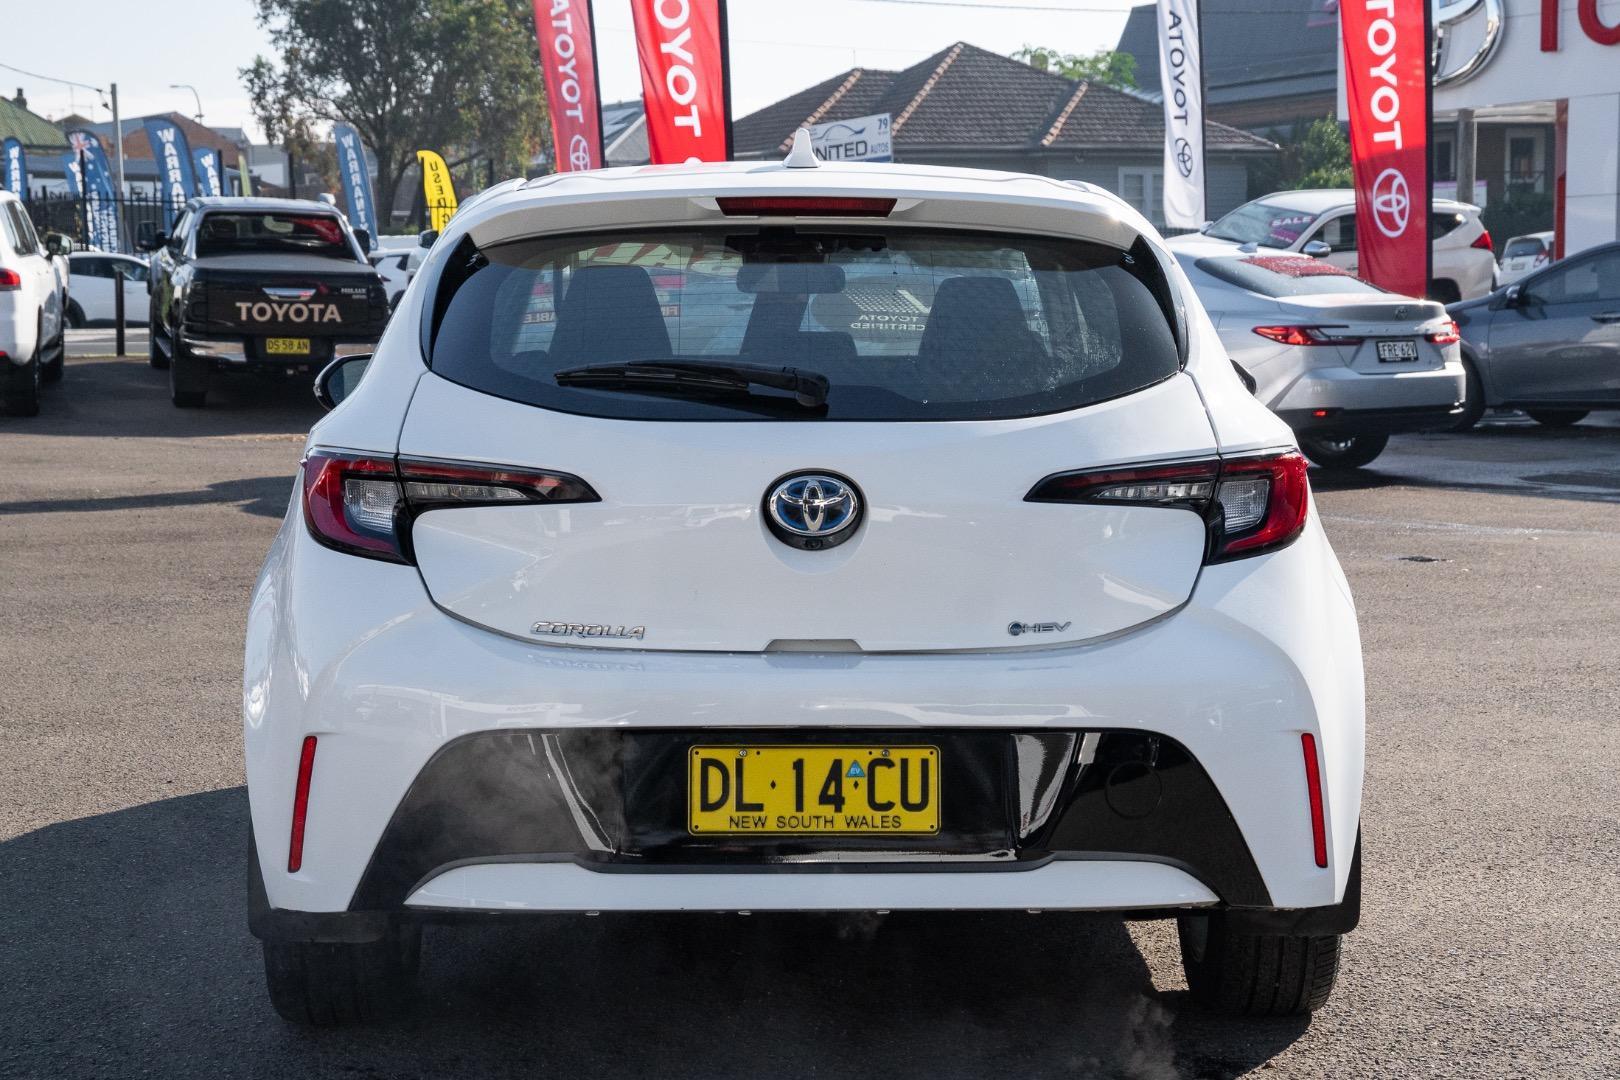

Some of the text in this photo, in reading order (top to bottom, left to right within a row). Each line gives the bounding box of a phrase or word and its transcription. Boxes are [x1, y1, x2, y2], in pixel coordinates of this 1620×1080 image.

[878, 118, 888, 130] 79
[235, 302, 342, 323] TOYOTA
[530, 621, 645, 640] COROLLA
[850, 766, 862, 775] EV
[729, 815, 902, 829] NEW SOUTH WALES
